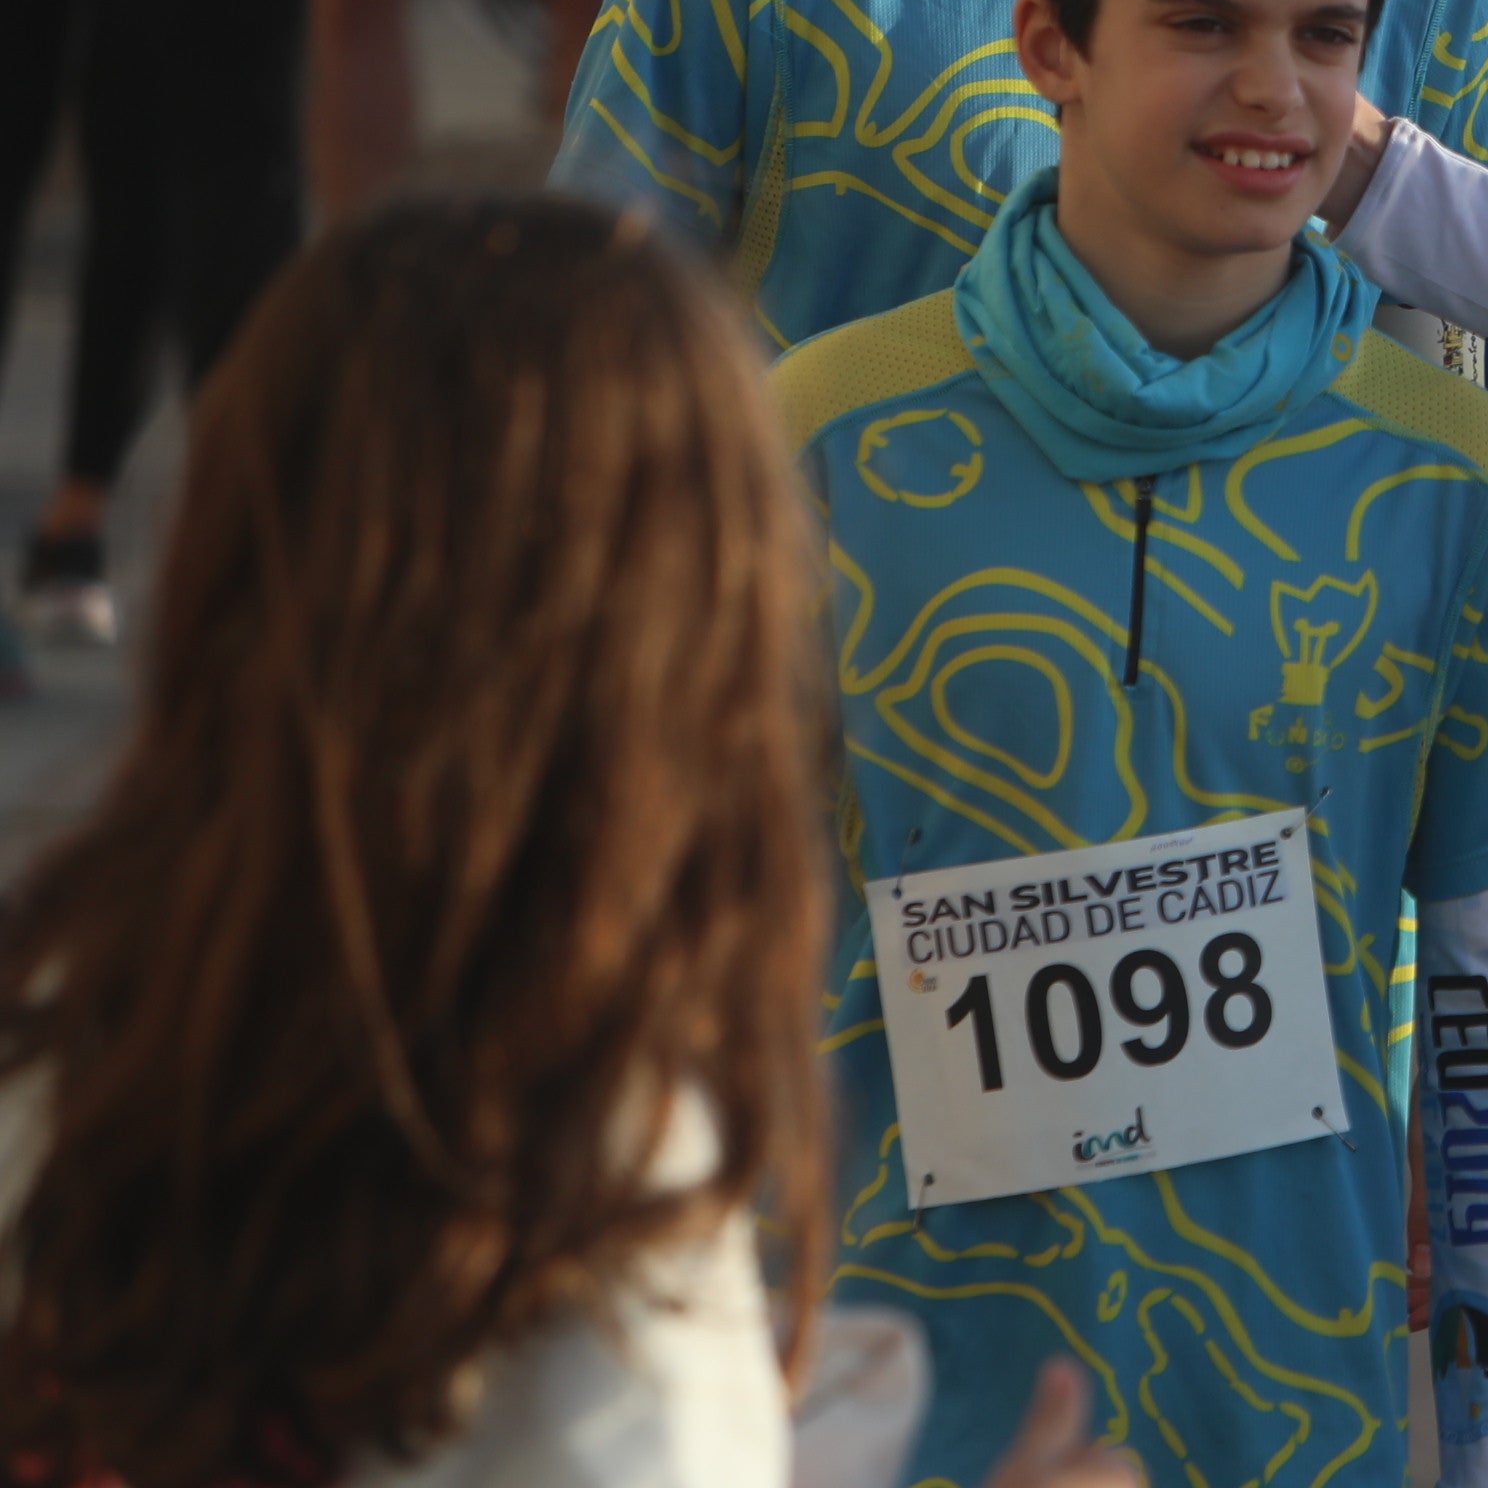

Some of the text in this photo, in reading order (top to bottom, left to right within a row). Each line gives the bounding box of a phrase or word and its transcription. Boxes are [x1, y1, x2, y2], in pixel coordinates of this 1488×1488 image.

[902, 841, 1281, 929] SAN SILVESTRE
[906, 912, 1071, 964] CIUDAD
[1085, 897, 1145, 938] DE
[945, 932, 1273, 1093] 1098
